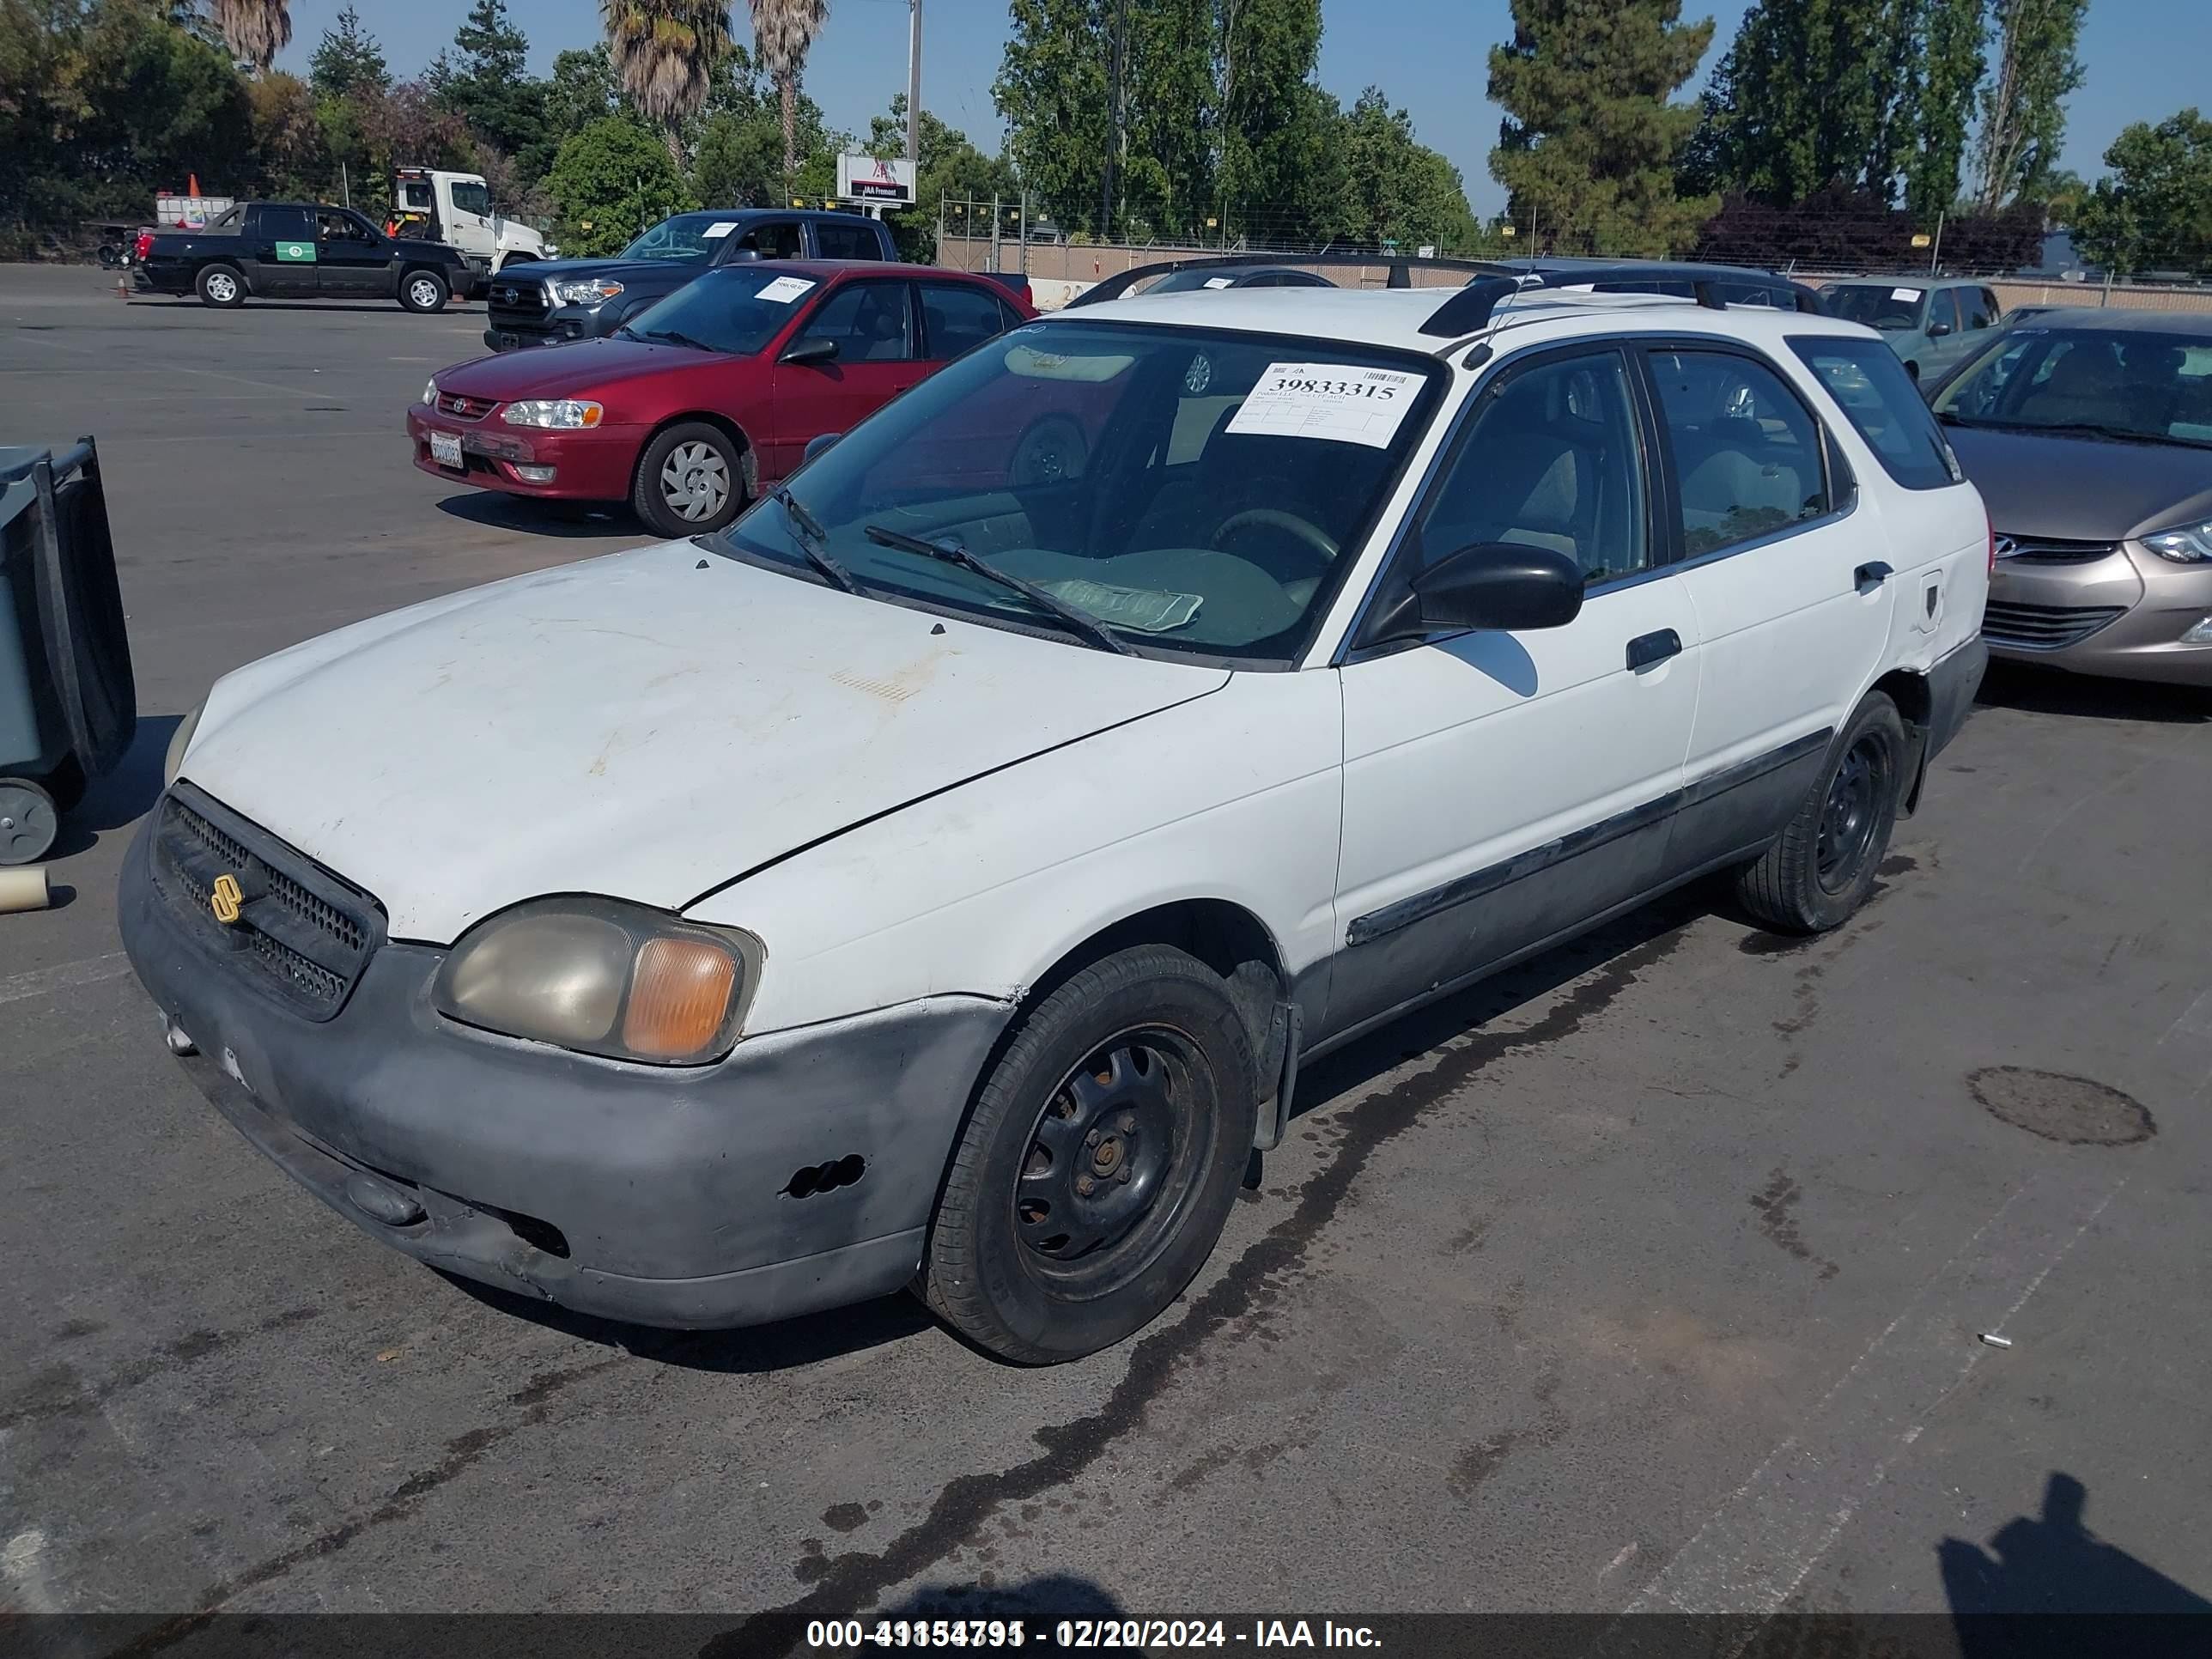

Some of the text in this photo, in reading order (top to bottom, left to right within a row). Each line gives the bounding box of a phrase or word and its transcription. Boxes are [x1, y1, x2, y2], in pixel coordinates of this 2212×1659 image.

[864, 185, 896, 196] IAA Fremont
[1269, 379, 1397, 400] 39833315
